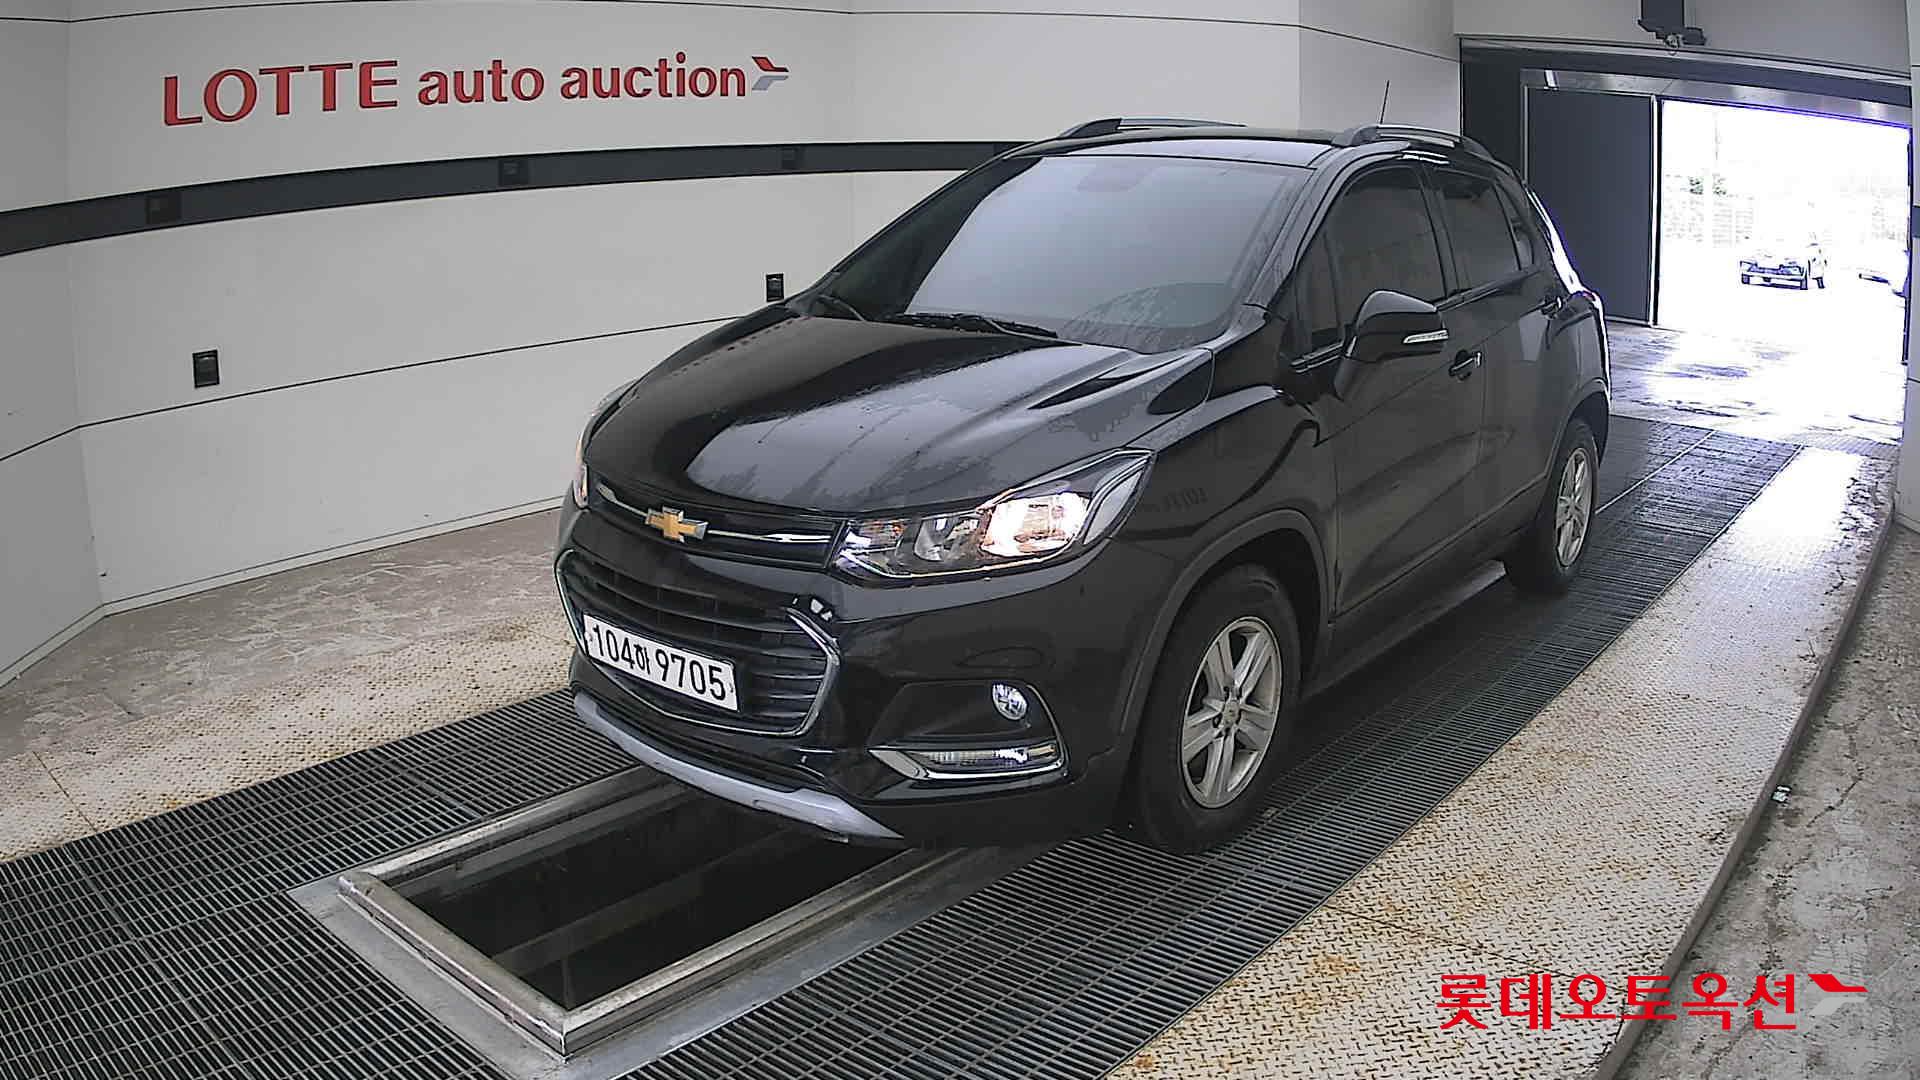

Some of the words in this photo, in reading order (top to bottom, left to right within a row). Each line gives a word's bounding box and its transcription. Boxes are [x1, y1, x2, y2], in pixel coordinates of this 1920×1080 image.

[162, 59, 399, 127] LOTTE
[416, 58, 545, 106] auto
[559, 51, 747, 99] auction
[593, 624, 651, 675] 104하
[655, 649, 726, 701] 9705
